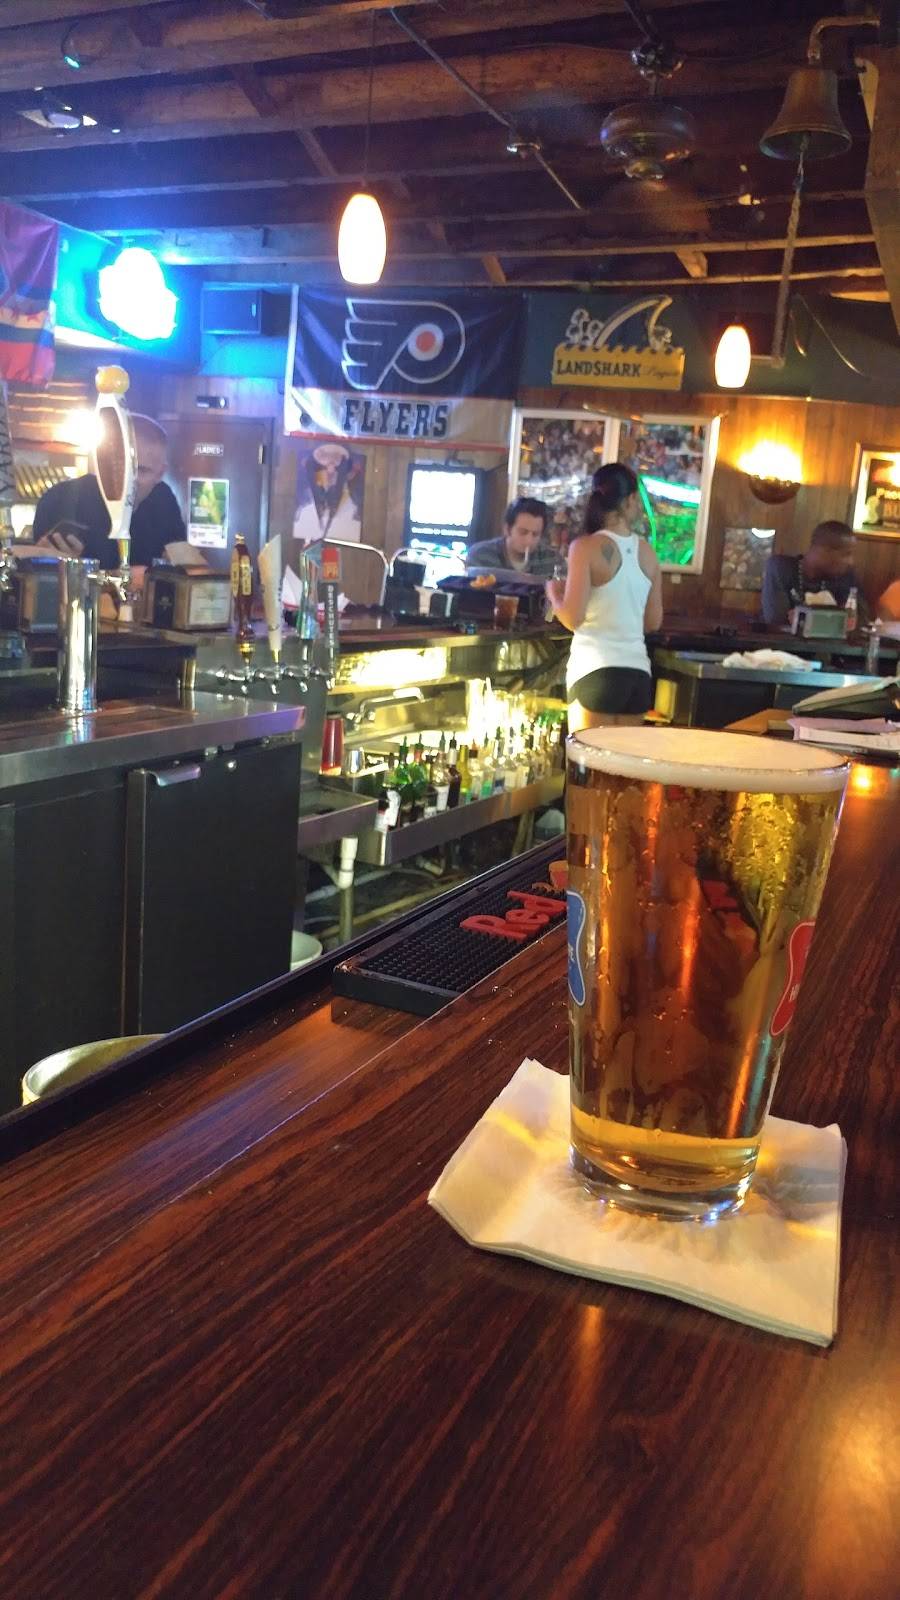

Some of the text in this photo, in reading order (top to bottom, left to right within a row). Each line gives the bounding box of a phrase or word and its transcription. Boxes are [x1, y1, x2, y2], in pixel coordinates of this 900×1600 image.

[556, 359, 642, 377] LANDSHARK
[343, 398, 449, 437] FLYERS
[460, 890, 567, 939] Red
